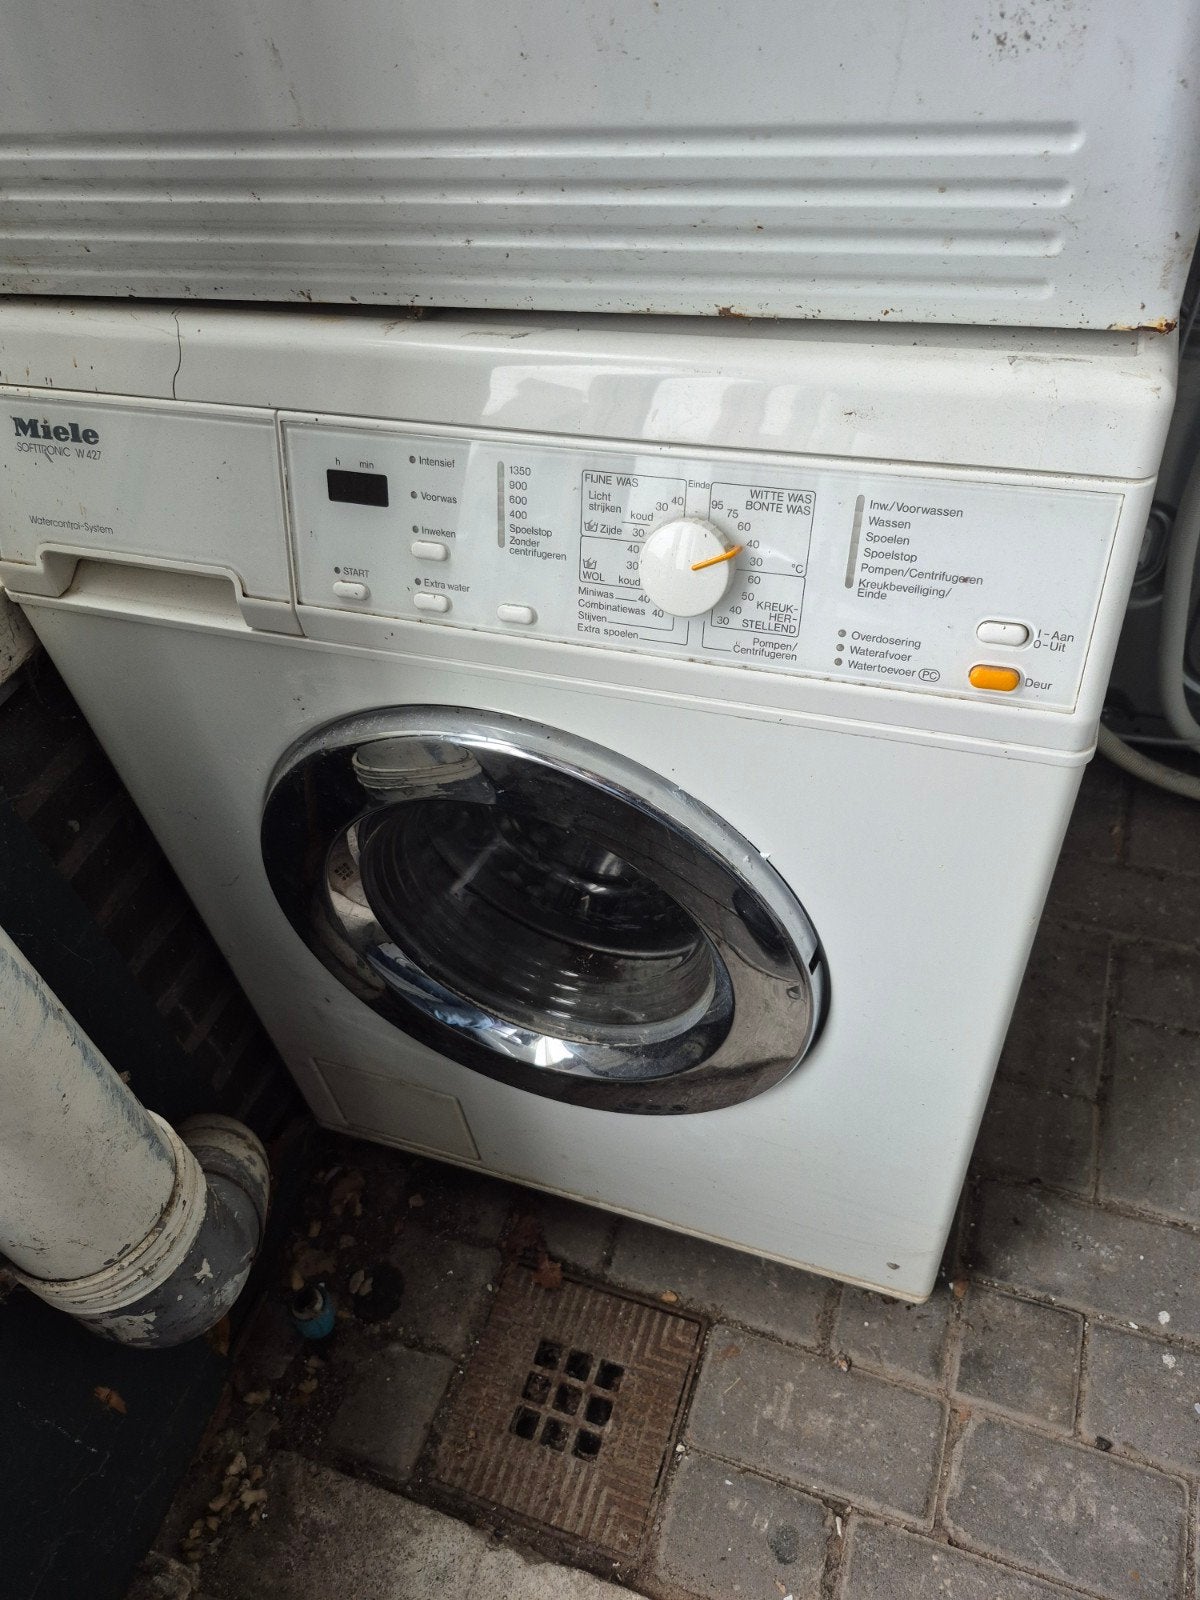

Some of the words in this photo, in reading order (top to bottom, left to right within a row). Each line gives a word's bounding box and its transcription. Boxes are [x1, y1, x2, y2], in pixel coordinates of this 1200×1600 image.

[12, 417, 99, 445] Miele
[76, 449, 84, 458] W
[87, 450, 101, 460] 427
[360, 461, 374, 469] min
[419, 456, 455, 468] Intensief
[509, 466, 531, 476] 1350
[509, 481, 527, 490] 900
[585, 474, 612, 485] FIJNE
[617, 478, 638, 487] WAS
[688, 480, 710, 489] Einde
[421, 492, 457, 503] Voorwas
[509, 496, 527, 505] 600
[589, 491, 611, 501] Licht
[672, 497, 683, 505] 40
[750, 490, 783, 502] WITTE
[787, 493, 812, 504] WAS
[589, 503, 621, 513] strijken
[656, 503, 668, 511] 30
[712, 501, 723, 510] 95
[746, 501, 782, 513] BONTE
[786, 505, 811, 515] WAS
[509, 510, 528, 520] 400
[631, 511, 653, 521] koud
[727, 510, 739, 518] 75
[29, 515, 113, 534] Watercontrol-System
[737, 522, 751, 531] 60
[868, 517, 911, 529] Wassen
[422, 526, 456, 538] Inweken
[509, 524, 552, 538] Spoelstop
[600, 524, 622, 535] Zijde
[632, 528, 645, 537] 30
[509, 536, 540, 548] Zonder
[747, 540, 759, 549] 40
[866, 533, 910, 546] Spoelen
[509, 548, 567, 561] centrifugeren
[627, 545, 640, 553] 40
[864, 548, 917, 563] Spoelstop
[626, 562, 639, 570] 30
[750, 557, 763, 566] 30
[344, 567, 370, 577] START
[583, 571, 605, 582] WOL
[424, 579, 446, 589] Extra
[447, 583, 470, 592] water
[618, 575, 640, 586] koud
[748, 576, 761, 585] 60
[578, 587, 614, 599] Miniwas
[638, 595, 650, 604] 40
[741, 592, 754, 601] 50
[857, 590, 887, 600] Einde
[578, 599, 646, 616] Combinatiewas
[652, 609, 665, 618] 40
[729, 606, 742, 615] 40
[756, 601, 798, 614] KREUK-
[578, 612, 607, 625] Stijven
[717, 616, 729, 625] 30
[769, 612, 797, 623] HER-
[577, 623, 600, 635] Extra
[604, 628, 639, 640] spoelen
[742, 619, 796, 634] STELLEND
[753, 638, 798, 652] Pompen/
[851, 631, 921, 650] Overdosering
[733, 644, 797, 661] Centrifugeren
[850, 645, 912, 662] Waterafvoer
[848, 660, 916, 677] Watertoevoer
[922, 670, 936, 680] PC
[1025, 677, 1052, 690] Deur
